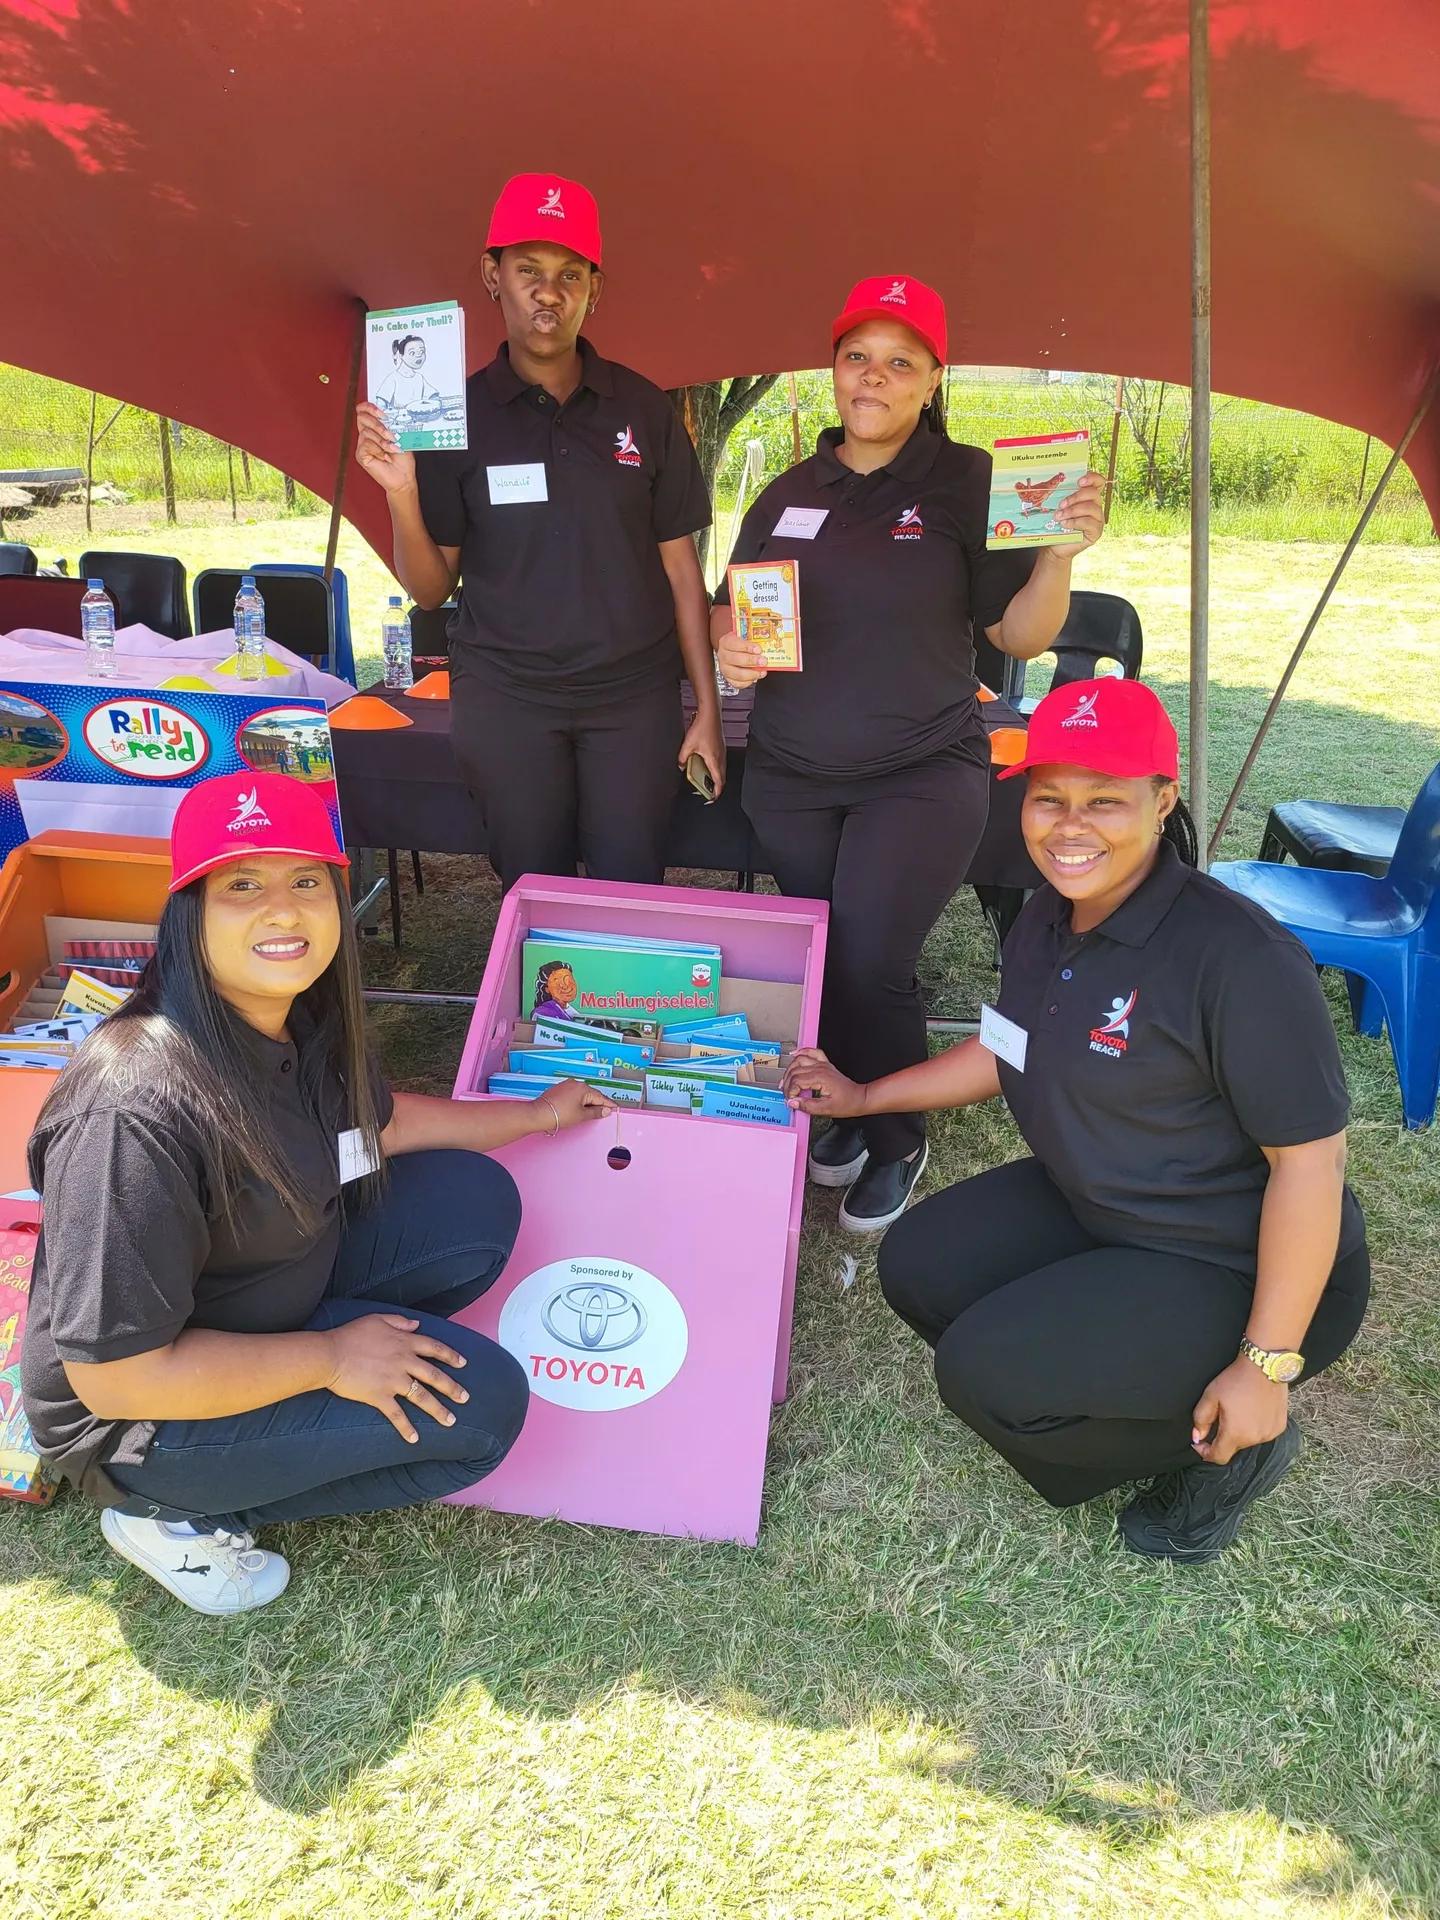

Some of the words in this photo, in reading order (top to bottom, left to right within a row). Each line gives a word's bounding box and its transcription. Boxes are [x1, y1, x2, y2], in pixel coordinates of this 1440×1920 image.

[537, 208, 565, 219] TOYOTA
[880, 296, 906, 305] TOYOTA
[371, 324, 384, 333] No
[386, 321, 409, 331] Cake
[411, 319, 424, 329] for
[613, 452, 643, 464] TOYOTA
[618, 459, 640, 468] REACH
[1011, 453, 1035, 461] UKuku
[891, 527, 923, 536] TOYOTA
[752, 580, 778, 592] Getting
[753, 592, 779, 603] dressed
[108, 707, 183, 746] Rally
[1061, 719, 1098, 729] TOYOTA
[111, 738, 126, 753] to
[127, 731, 196, 762] read
[226, 818, 273, 833] TOYOTA
[580, 990, 715, 1014] Masilungiselele!
[539, 1029, 551, 1040] No
[1089, 1029, 1128, 1052] TOYOTA
[1089, 1041, 1122, 1058] REACH
[650, 1079, 675, 1094] Tikky
[729, 1100, 771, 1113] UJakalase
[715, 1108, 750, 1120] engodini
[751, 1113, 783, 1125] kaKuku
[570, 1264, 620, 1279] Sponsored
[621, 1268, 634, 1281] by
[529, 1355, 646, 1390] TOYOTA
